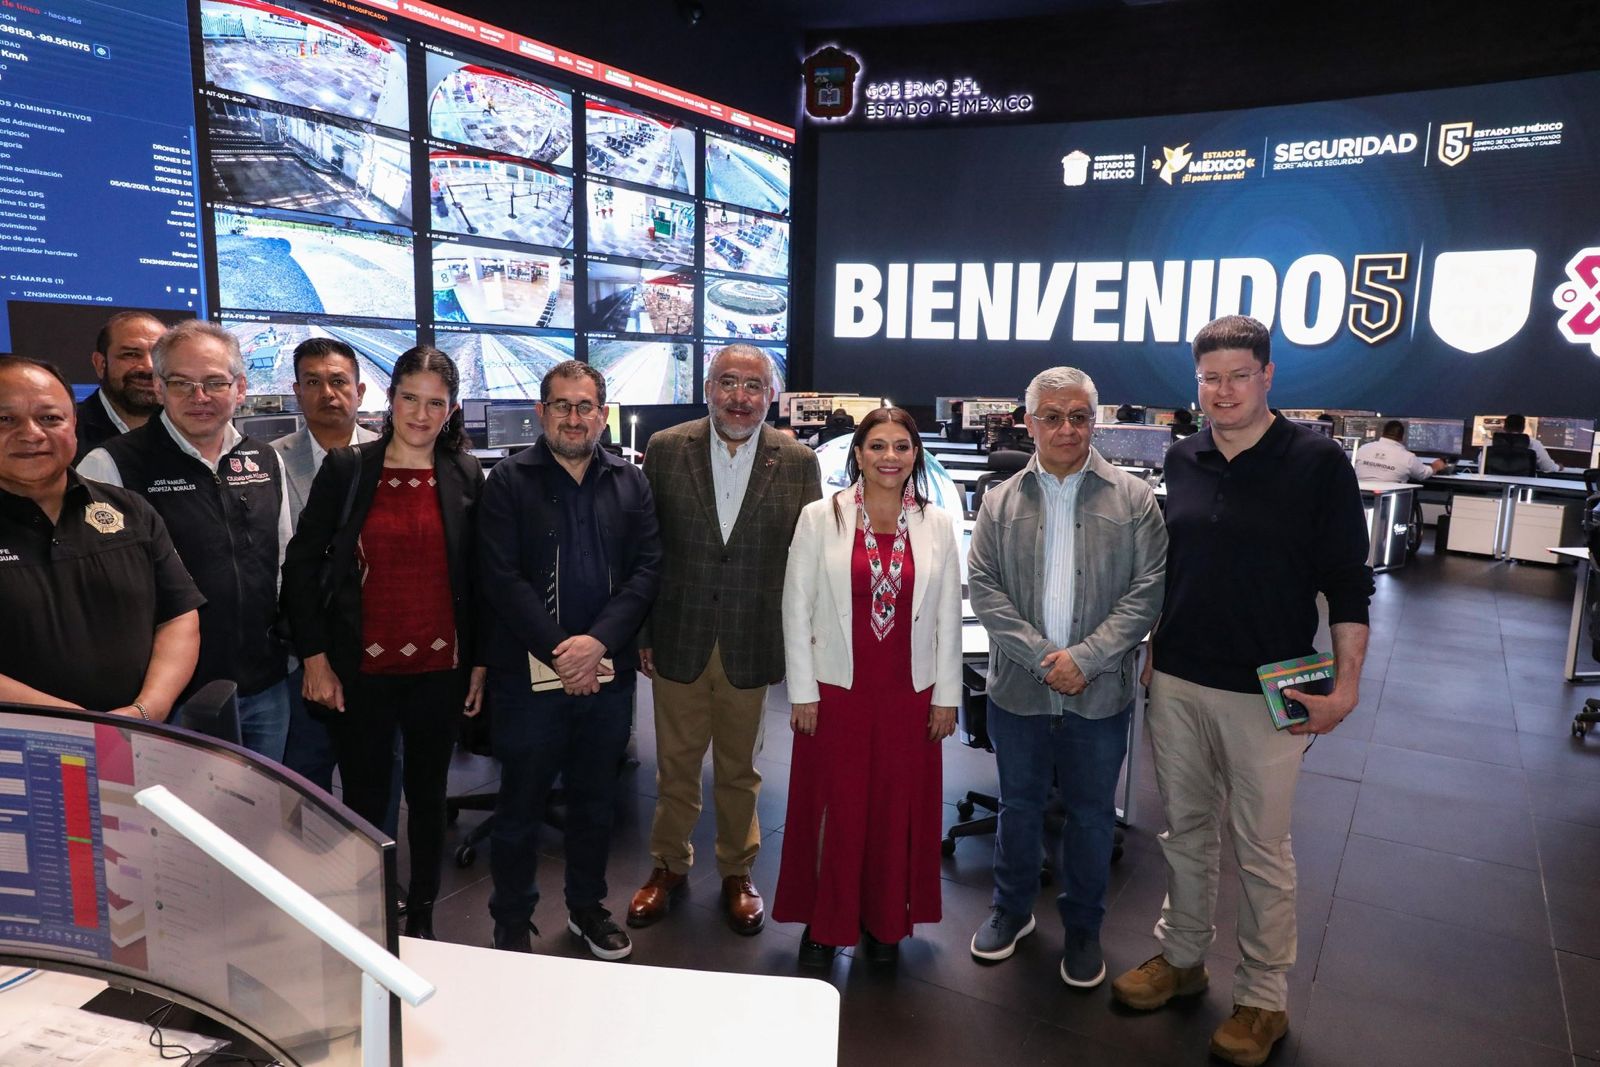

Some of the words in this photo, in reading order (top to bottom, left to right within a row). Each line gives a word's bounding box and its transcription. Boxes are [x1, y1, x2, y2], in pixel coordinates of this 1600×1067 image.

[1, 49, 28, 62] Km/h
[866, 79, 948, 99] GOBERNO
[951, 77, 981, 96] DEL
[14, 102, 92, 122] ADMINISTRATIVOS
[866, 100, 933, 119] ESTADO
[937, 98, 960, 116] DE
[963, 94, 1033, 115] MÉXICO
[12, 118, 65, 133] Administrativa
[1473, 127, 1511, 138] ESTADO
[1511, 125, 1525, 134] DE
[1526, 121, 1563, 133] MÉXICO
[153, 144, 180, 154] DRONES
[1274, 132, 1418, 163] SEGURIDAD
[154, 154, 181, 164] DRONES
[1203, 151, 1234, 159] ESTADO
[1235, 149, 1246, 157] DE
[1094, 161, 1123, 169] ESTADO
[1124, 160, 1135, 168] DE
[1188, 158, 1245, 173] MÉXICO
[14, 167, 63, 178] actualización
[154, 165, 182, 175] DRONES
[1093, 168, 1135, 180] MÉXICO
[155, 176, 182, 185] DRONES
[1191, 173, 1212, 183] poder
[1213, 172, 1222, 180] de
[28, 190, 45, 198] GPS
[24, 236, 46, 244] alerta
[44, 249, 78, 258] hardware
[10, 274, 53, 283] CÁMARAS
[834, 253, 1346, 346] BIENVENIDO
[1363, 460, 1396, 471] SEGURIDAD
[154, 478, 166, 486] JOSÉ
[147, 485, 172, 493] OROPEZA
